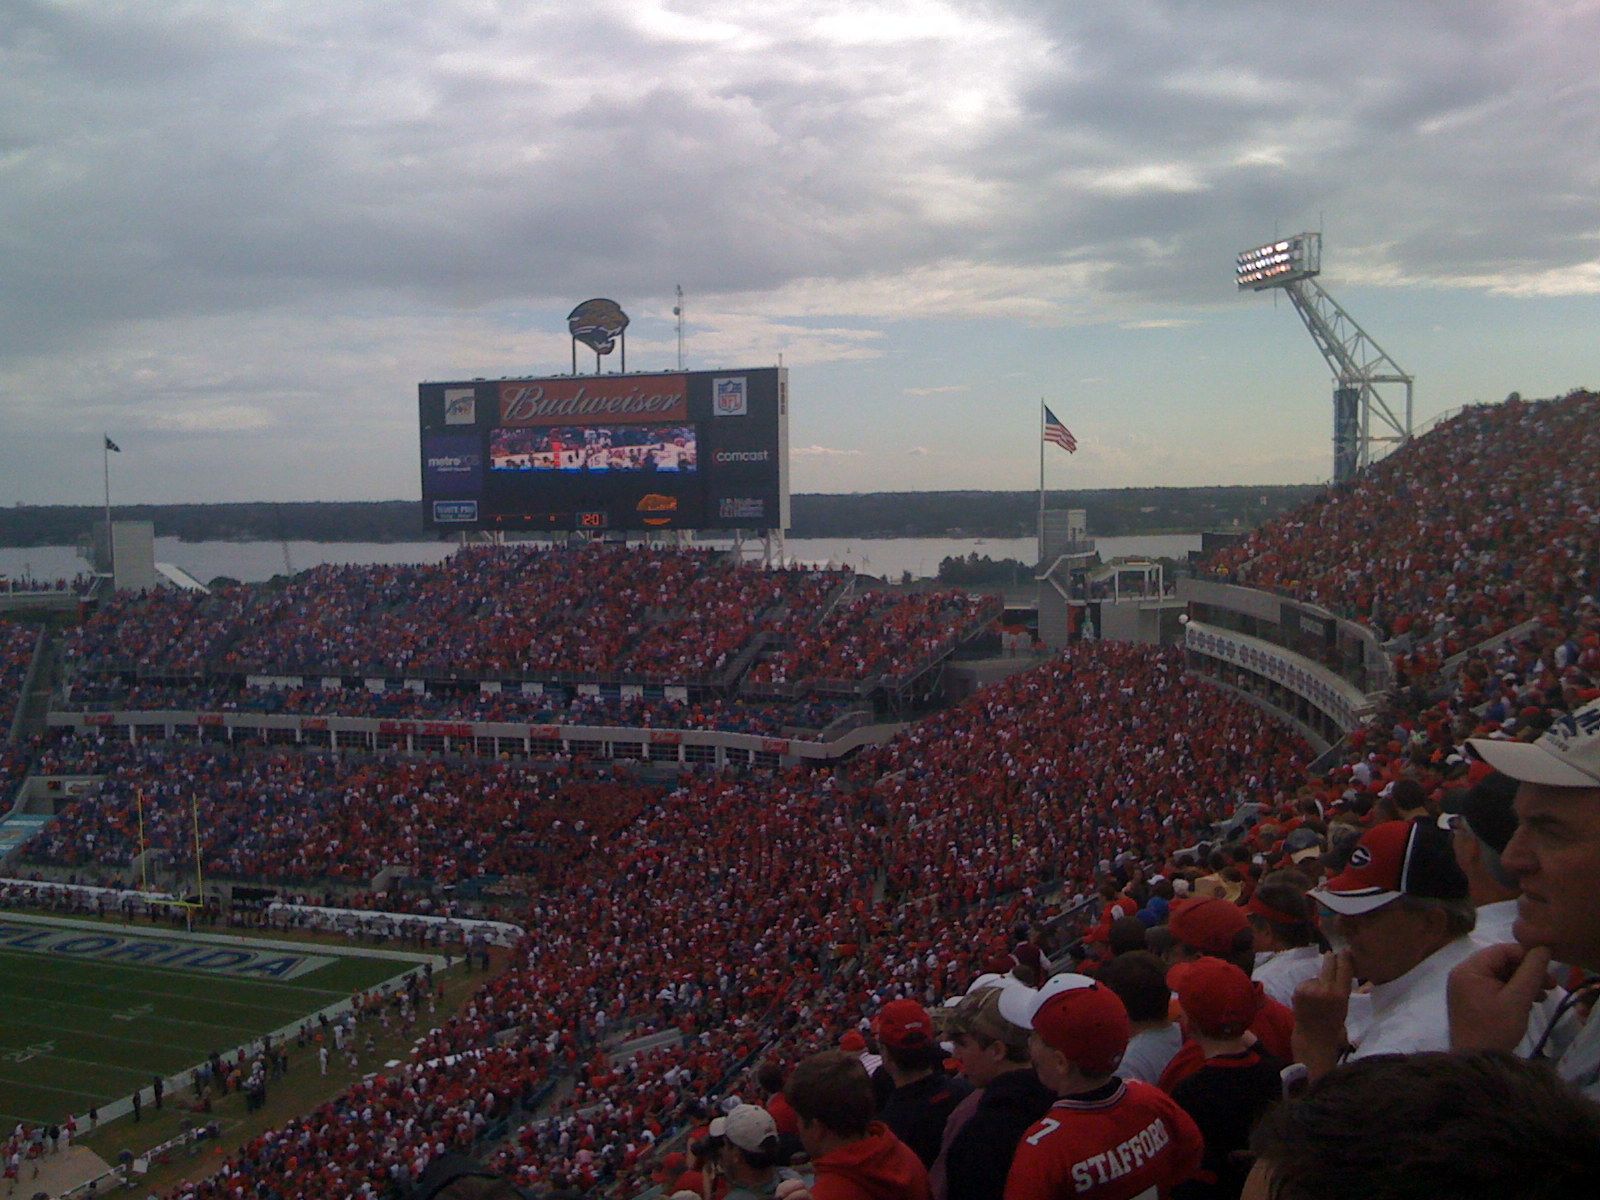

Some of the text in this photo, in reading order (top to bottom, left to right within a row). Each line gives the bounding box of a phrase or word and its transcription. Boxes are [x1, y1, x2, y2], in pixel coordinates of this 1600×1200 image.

[502, 385, 682, 421] Budweiser
[716, 450, 768, 462] comcast
[1026, 1117, 1061, 1146] 7
